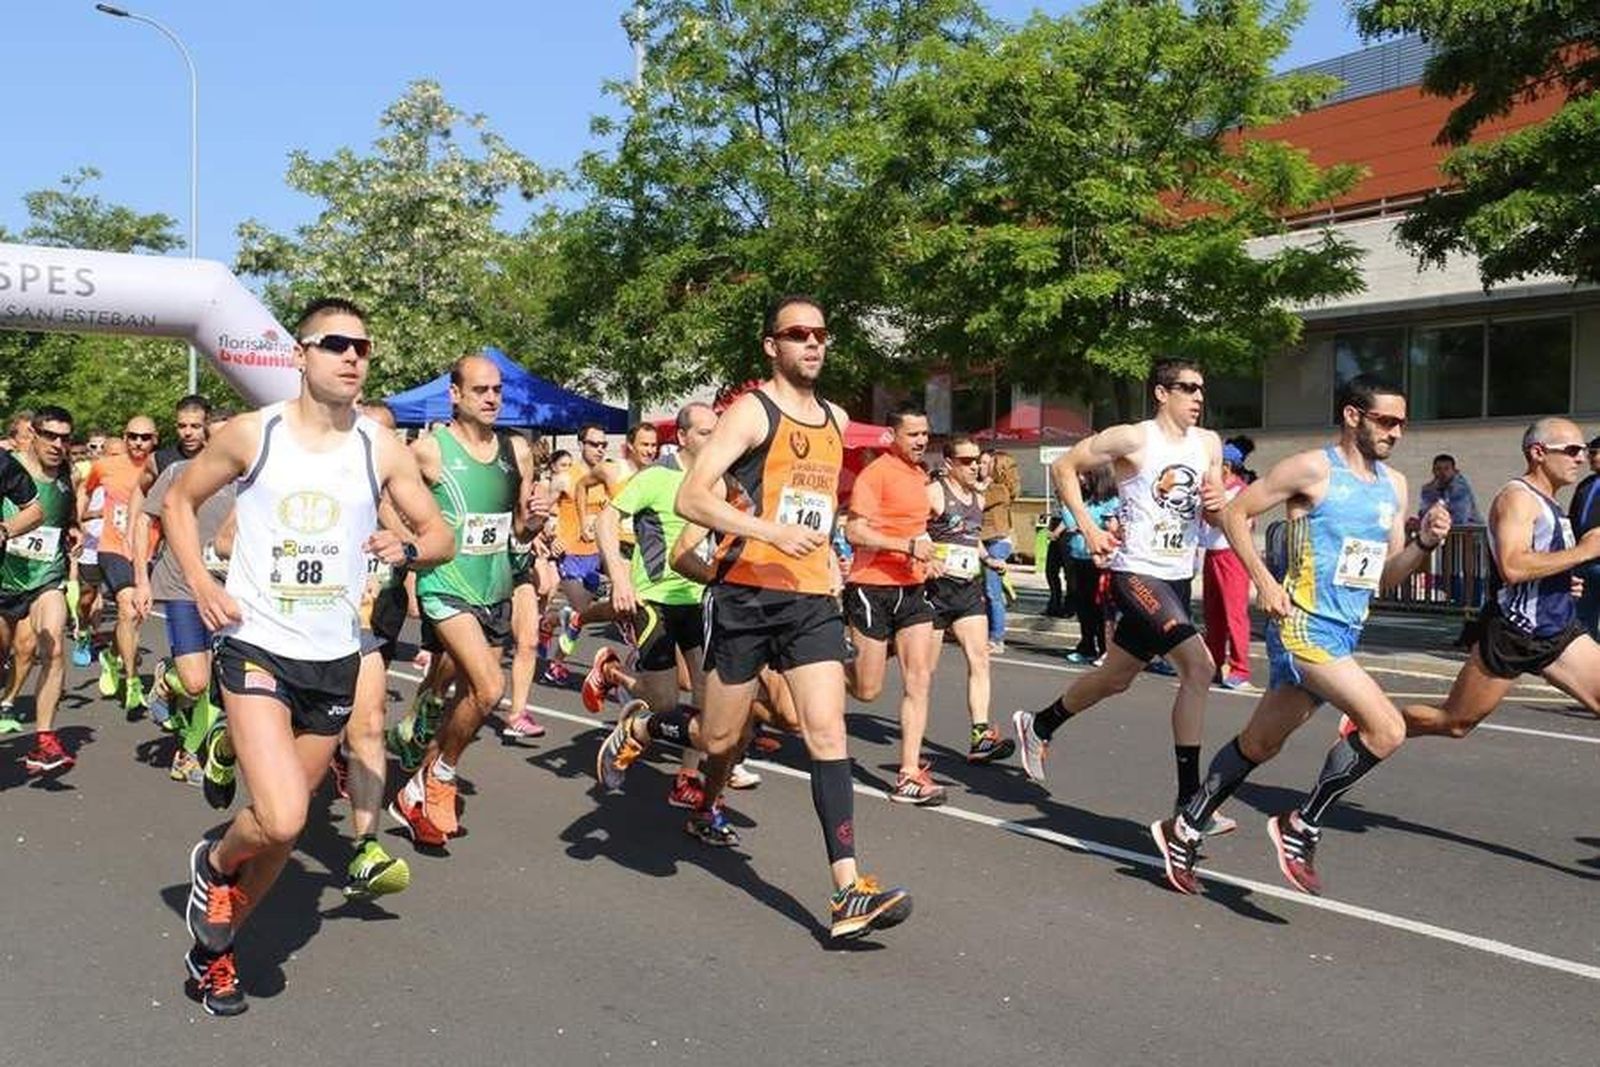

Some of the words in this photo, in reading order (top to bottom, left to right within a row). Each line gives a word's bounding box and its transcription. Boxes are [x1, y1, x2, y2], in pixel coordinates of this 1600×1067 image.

[6, 303, 54, 323] SAN
[62, 307, 156, 328] ESTEBAN
[797, 508, 821, 530] 140
[27, 536, 44, 552] 76
[481, 527, 497, 545] 85
[1163, 531, 1184, 549] 142
[296, 559, 324, 585] 88
